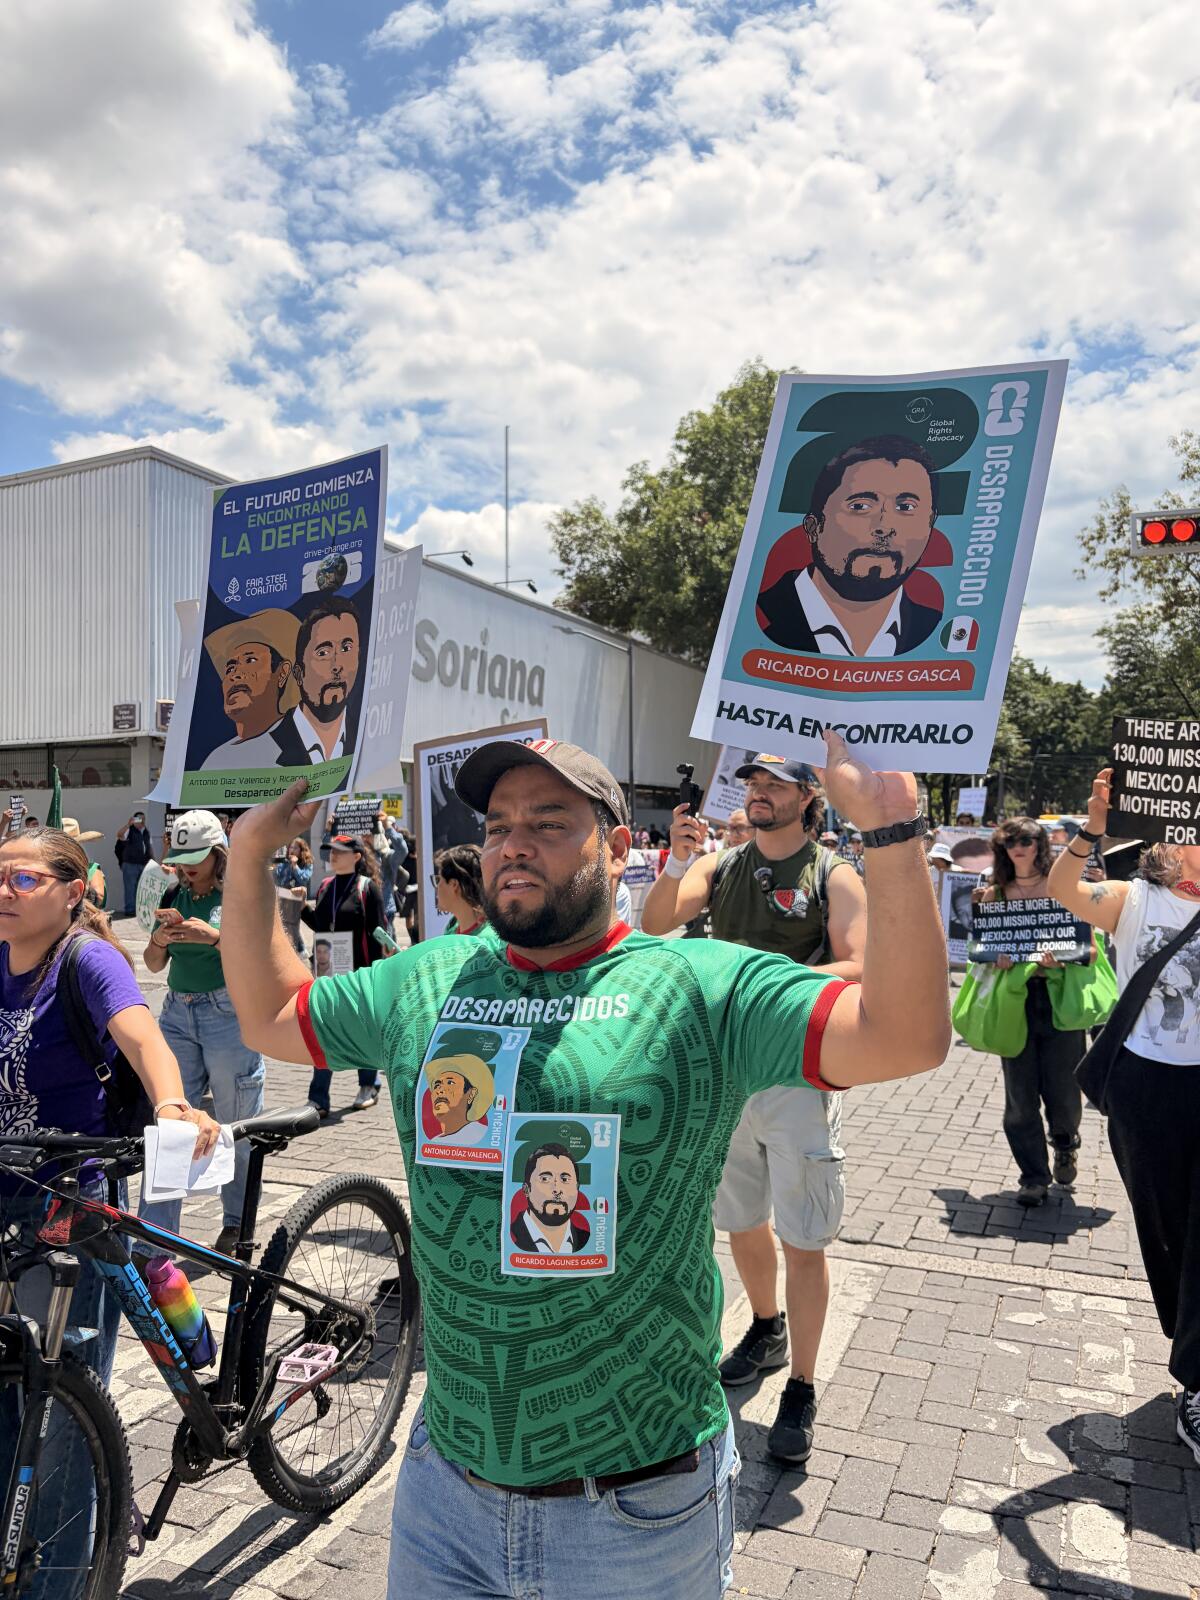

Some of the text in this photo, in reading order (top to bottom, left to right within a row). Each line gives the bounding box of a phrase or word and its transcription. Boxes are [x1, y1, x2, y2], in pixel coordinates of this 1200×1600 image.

[928, 427, 953, 436] Rights
[930, 419, 955, 427] Global
[926, 434, 965, 442] Advocacy
[223, 467, 375, 516] EL FUTURO COMIENZA
[248, 493, 349, 528] ENCONTRANDO
[221, 506, 368, 559] LA DEFENSA
[957, 445, 1014, 607] DESAPARECIDO
[304, 539, 363, 559] drive-change.org
[245, 573, 288, 588] FAIR STEEL
[245, 582, 288, 597] COALITION
[412, 618, 546, 707] Soriana
[757, 657, 961, 684] RICARDO LAGUNES GASCA
[716, 700, 794, 734] HASTA
[1125, 718, 1200, 741] THERE AR
[1113, 743, 1200, 768] 130,000 MISS
[239, 777, 270, 785] Valencia
[1126, 770, 1183, 792] MEXICO
[1120, 794, 1191, 819] MOTHERS
[177, 829, 188, 846] C
[1165, 825, 1197, 844] FOR
[978, 901, 1006, 914] THERE
[1007, 900, 1024, 912] ARE
[1025, 898, 1050, 911] MORE
[1003, 914, 1036, 927] MISSING
[1038, 911, 1071, 925] PEOPLE
[981, 926, 1076, 942] MEXICO AND ONLY OUR
[976, 943, 1017, 952] MOTHERS
[1017, 942, 1036, 951] ARE
[1036, 941, 1077, 952] LOOKING
[440, 993, 630, 1024] DESAPARECIDOS
[424, 1147, 499, 1160] ANTONIO DÍAZ VALENCIA
[515, 1257, 603, 1266] RICARDO LAGUNES GASCA
[337, 1469, 357, 1491] TEAM
[357, 1450, 376, 1476] ISSUE
[10, 1487, 28, 1542] SUNTOUR
